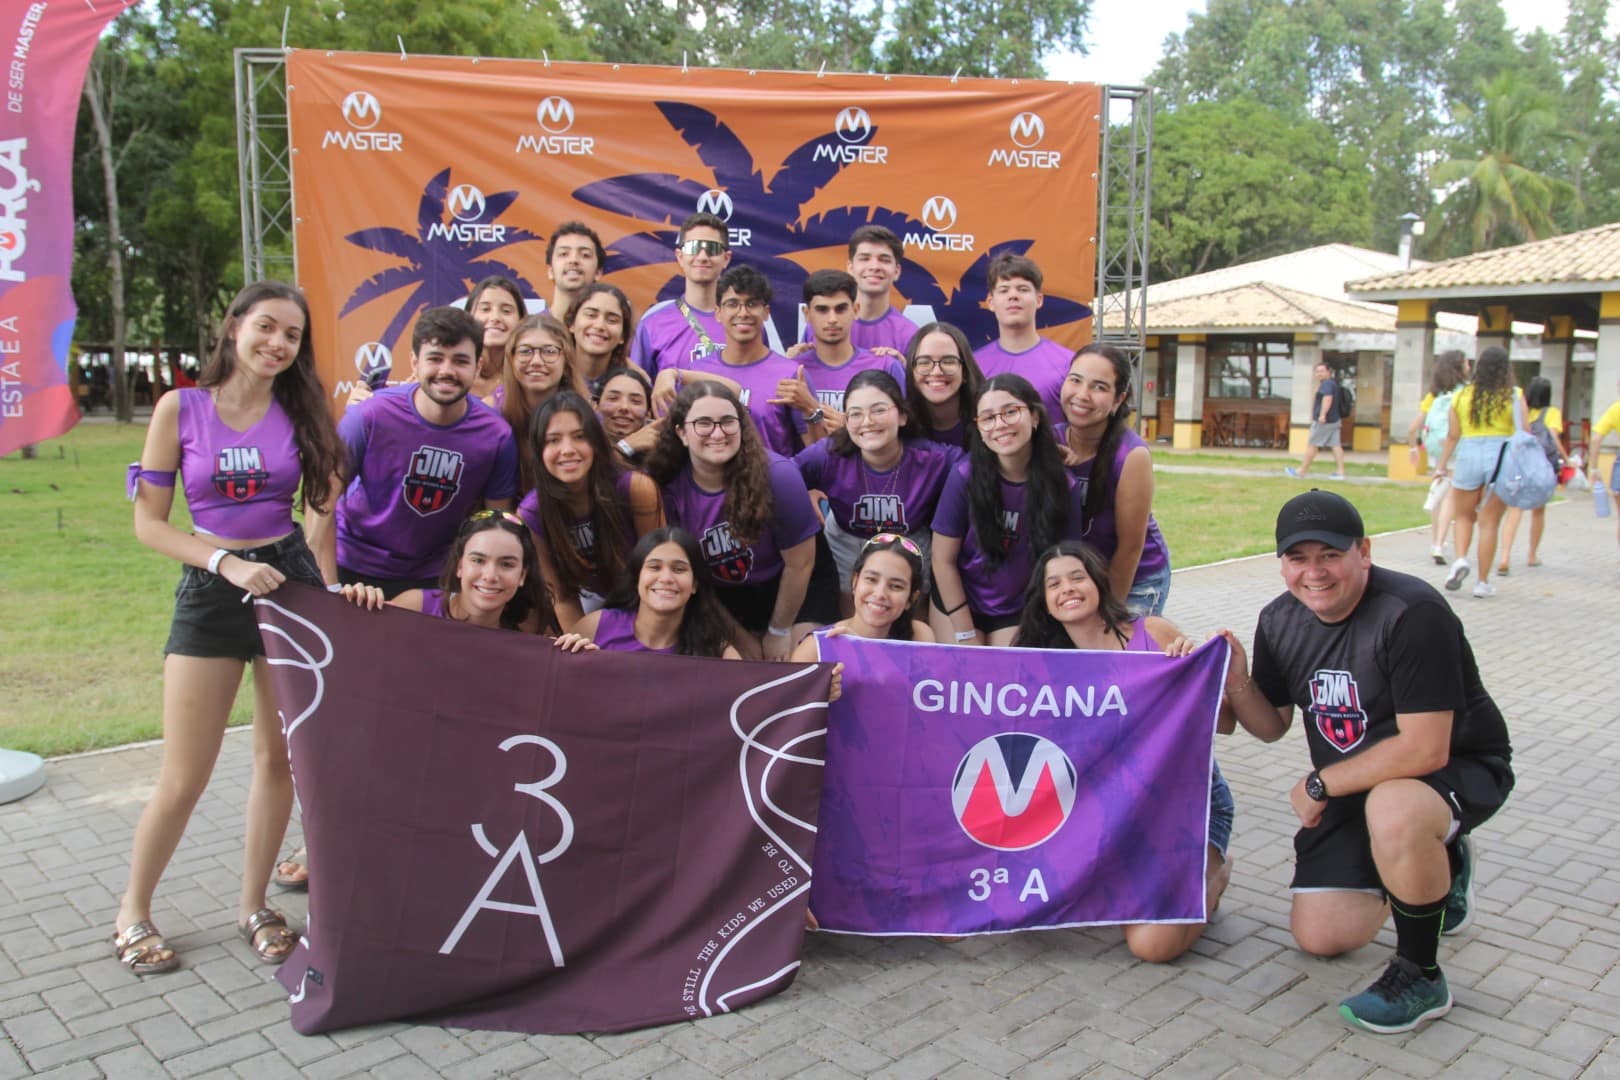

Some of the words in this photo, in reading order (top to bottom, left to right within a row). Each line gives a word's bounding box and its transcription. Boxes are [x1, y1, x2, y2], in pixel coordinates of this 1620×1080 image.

[9, 60, 25, 90] SER
[8, 91, 23, 113] DE
[322, 131, 403, 152] MASTER
[516, 135, 594, 156] MASTER
[812, 144, 888, 165] MASTER
[987, 149, 1061, 169] MASTER
[427, 223, 506, 243] MASTER
[903, 232, 975, 252] MASTER
[219, 447, 261, 471] JIM
[415, 448, 459, 481] JIM
[860, 497, 899, 522] JIM
[912, 679, 1128, 718] GINCANA
[1316, 673, 1353, 707] JIM
[761, 842, 779, 858] BE
[778, 858, 795, 875] TO
[767, 876, 798, 899] USED
[1019, 868, 1049, 902] A
[747, 897, 766, 913] WE
[717, 912, 747, 939] KIDS
[697, 939, 719, 962] THE
[682, 967, 701, 1002] STILL
